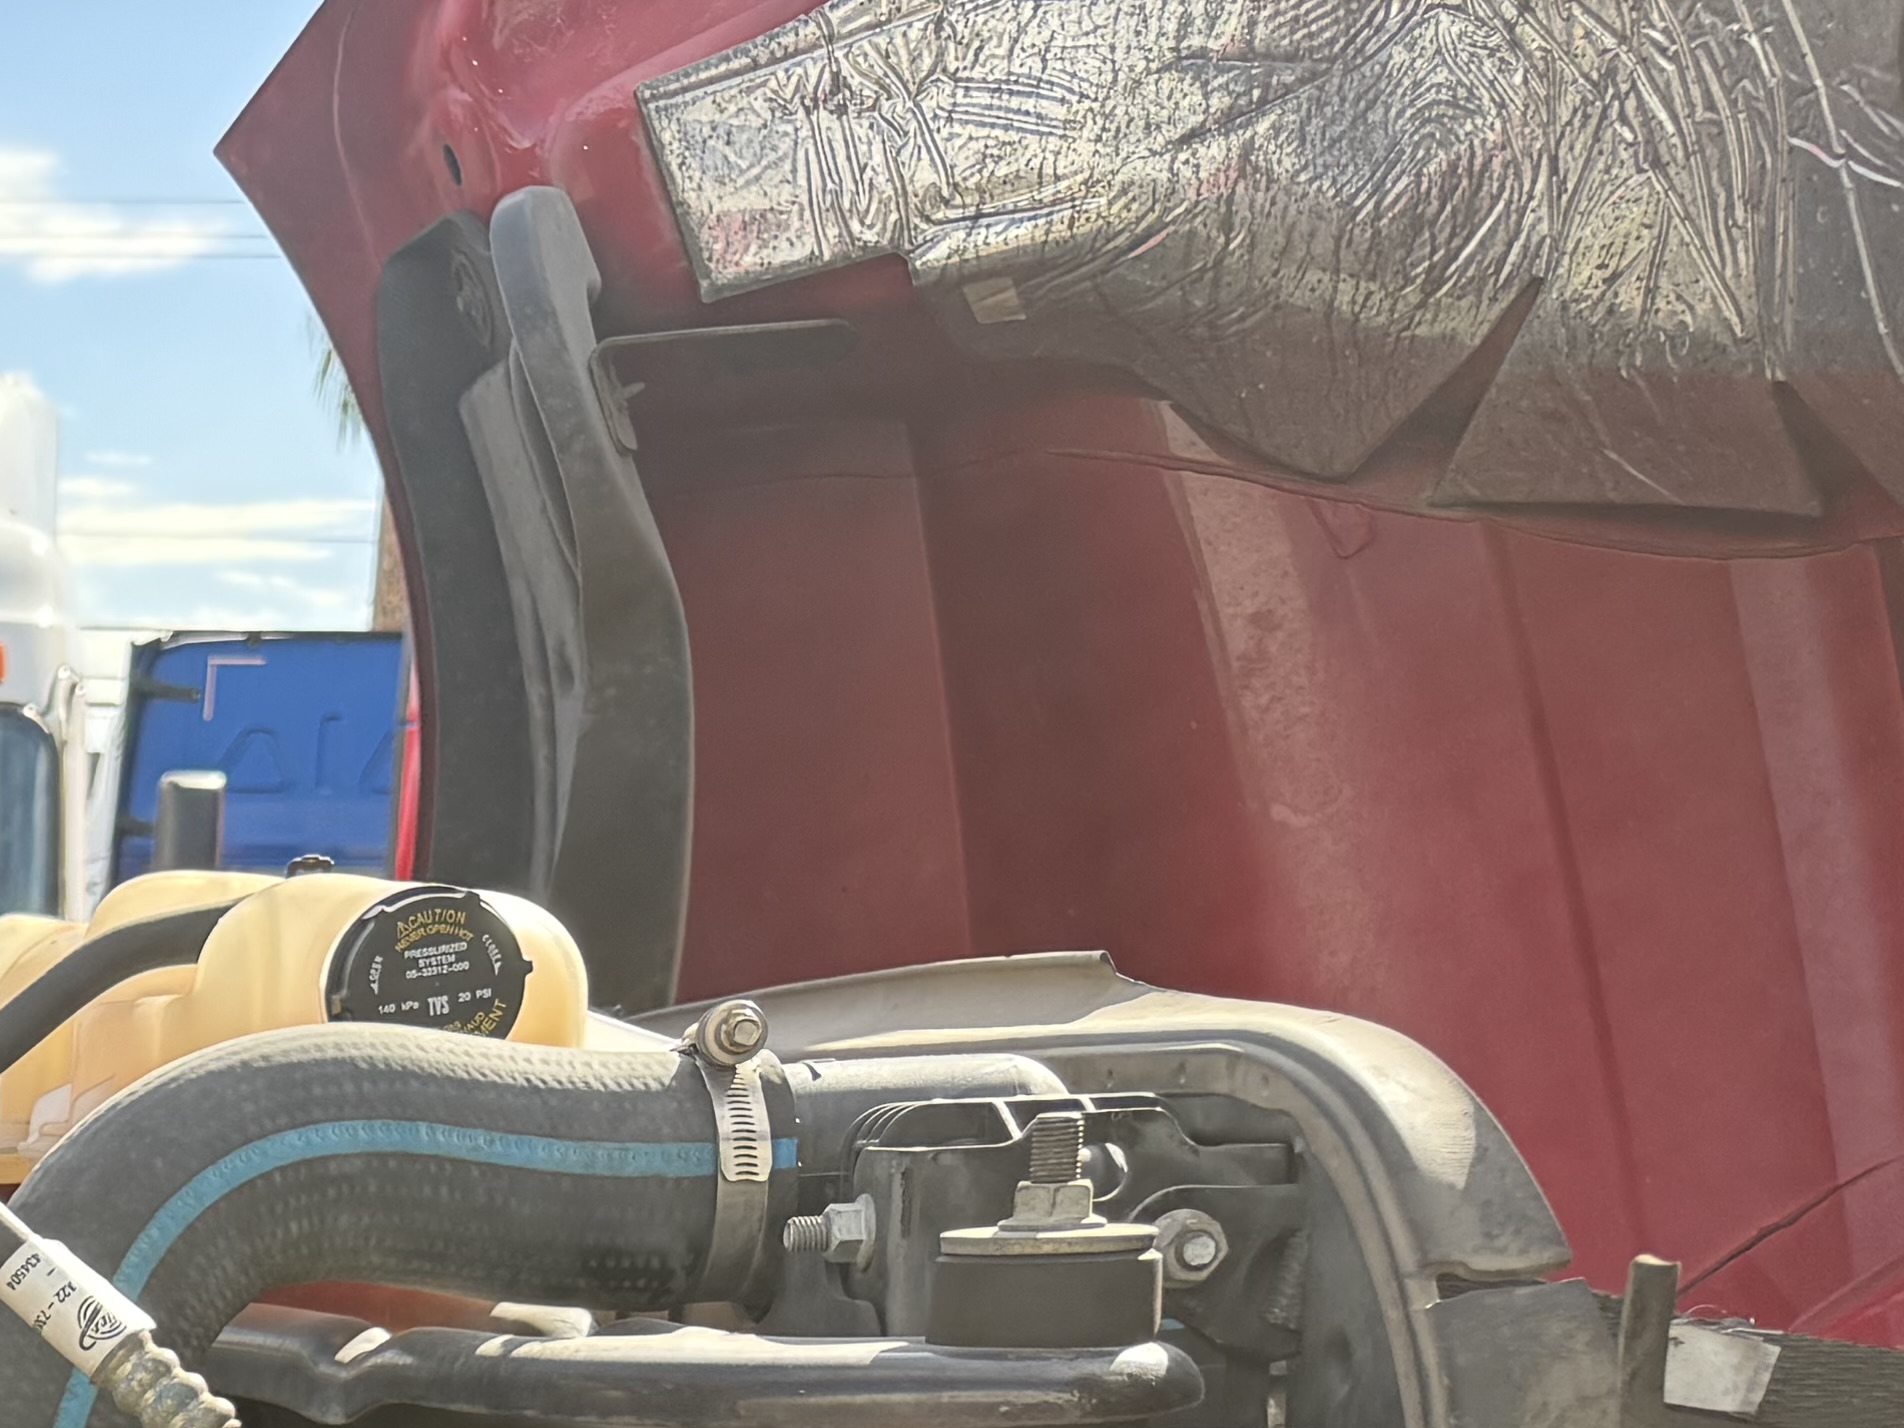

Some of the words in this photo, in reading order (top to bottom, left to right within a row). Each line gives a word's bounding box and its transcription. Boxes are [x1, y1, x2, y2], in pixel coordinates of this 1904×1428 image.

[408, 908, 466, 929] CAUTION
[395, 930, 426, 952] NEVER
[426, 924, 453, 935] OPEN
[404, 942, 468, 960] PRESSURIZED
[418, 954, 456, 968] SYSTEM
[457, 992, 471, 1002] 20
[476, 988, 492, 999] PSI
[378, 1003, 396, 1015] 140
[427, 995, 450, 1016] TVS
